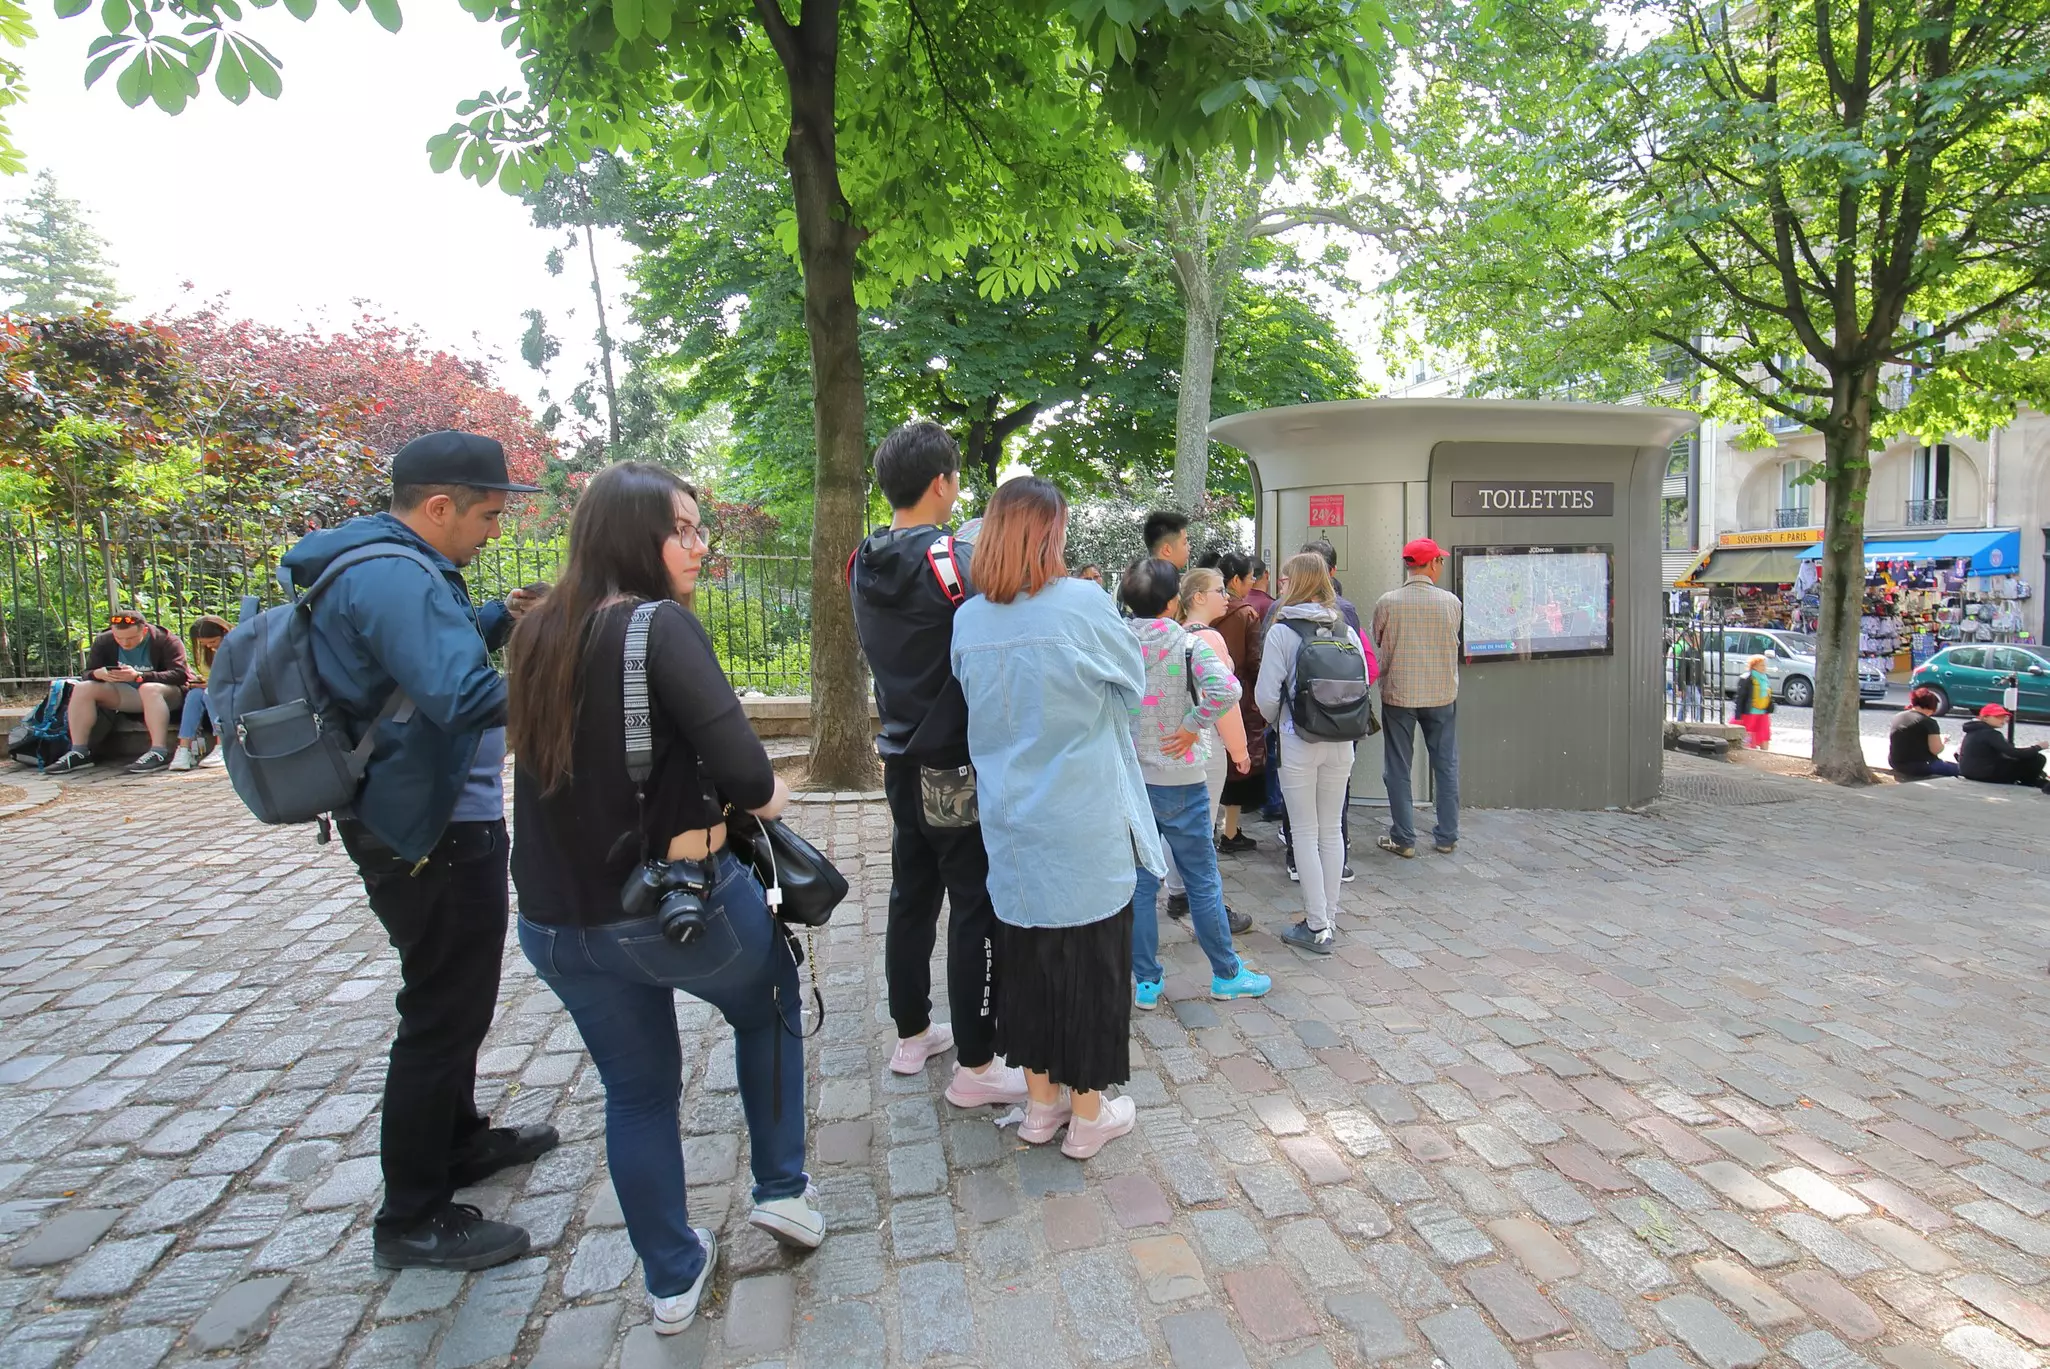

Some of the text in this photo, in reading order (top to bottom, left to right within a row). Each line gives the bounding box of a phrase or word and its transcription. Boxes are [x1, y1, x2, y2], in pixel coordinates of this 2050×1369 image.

[1478, 489, 1594, 509] TOILETTES
[1737, 534, 1773, 544] SOUVENIRS
[1787, 532, 1807, 542] PARIS
